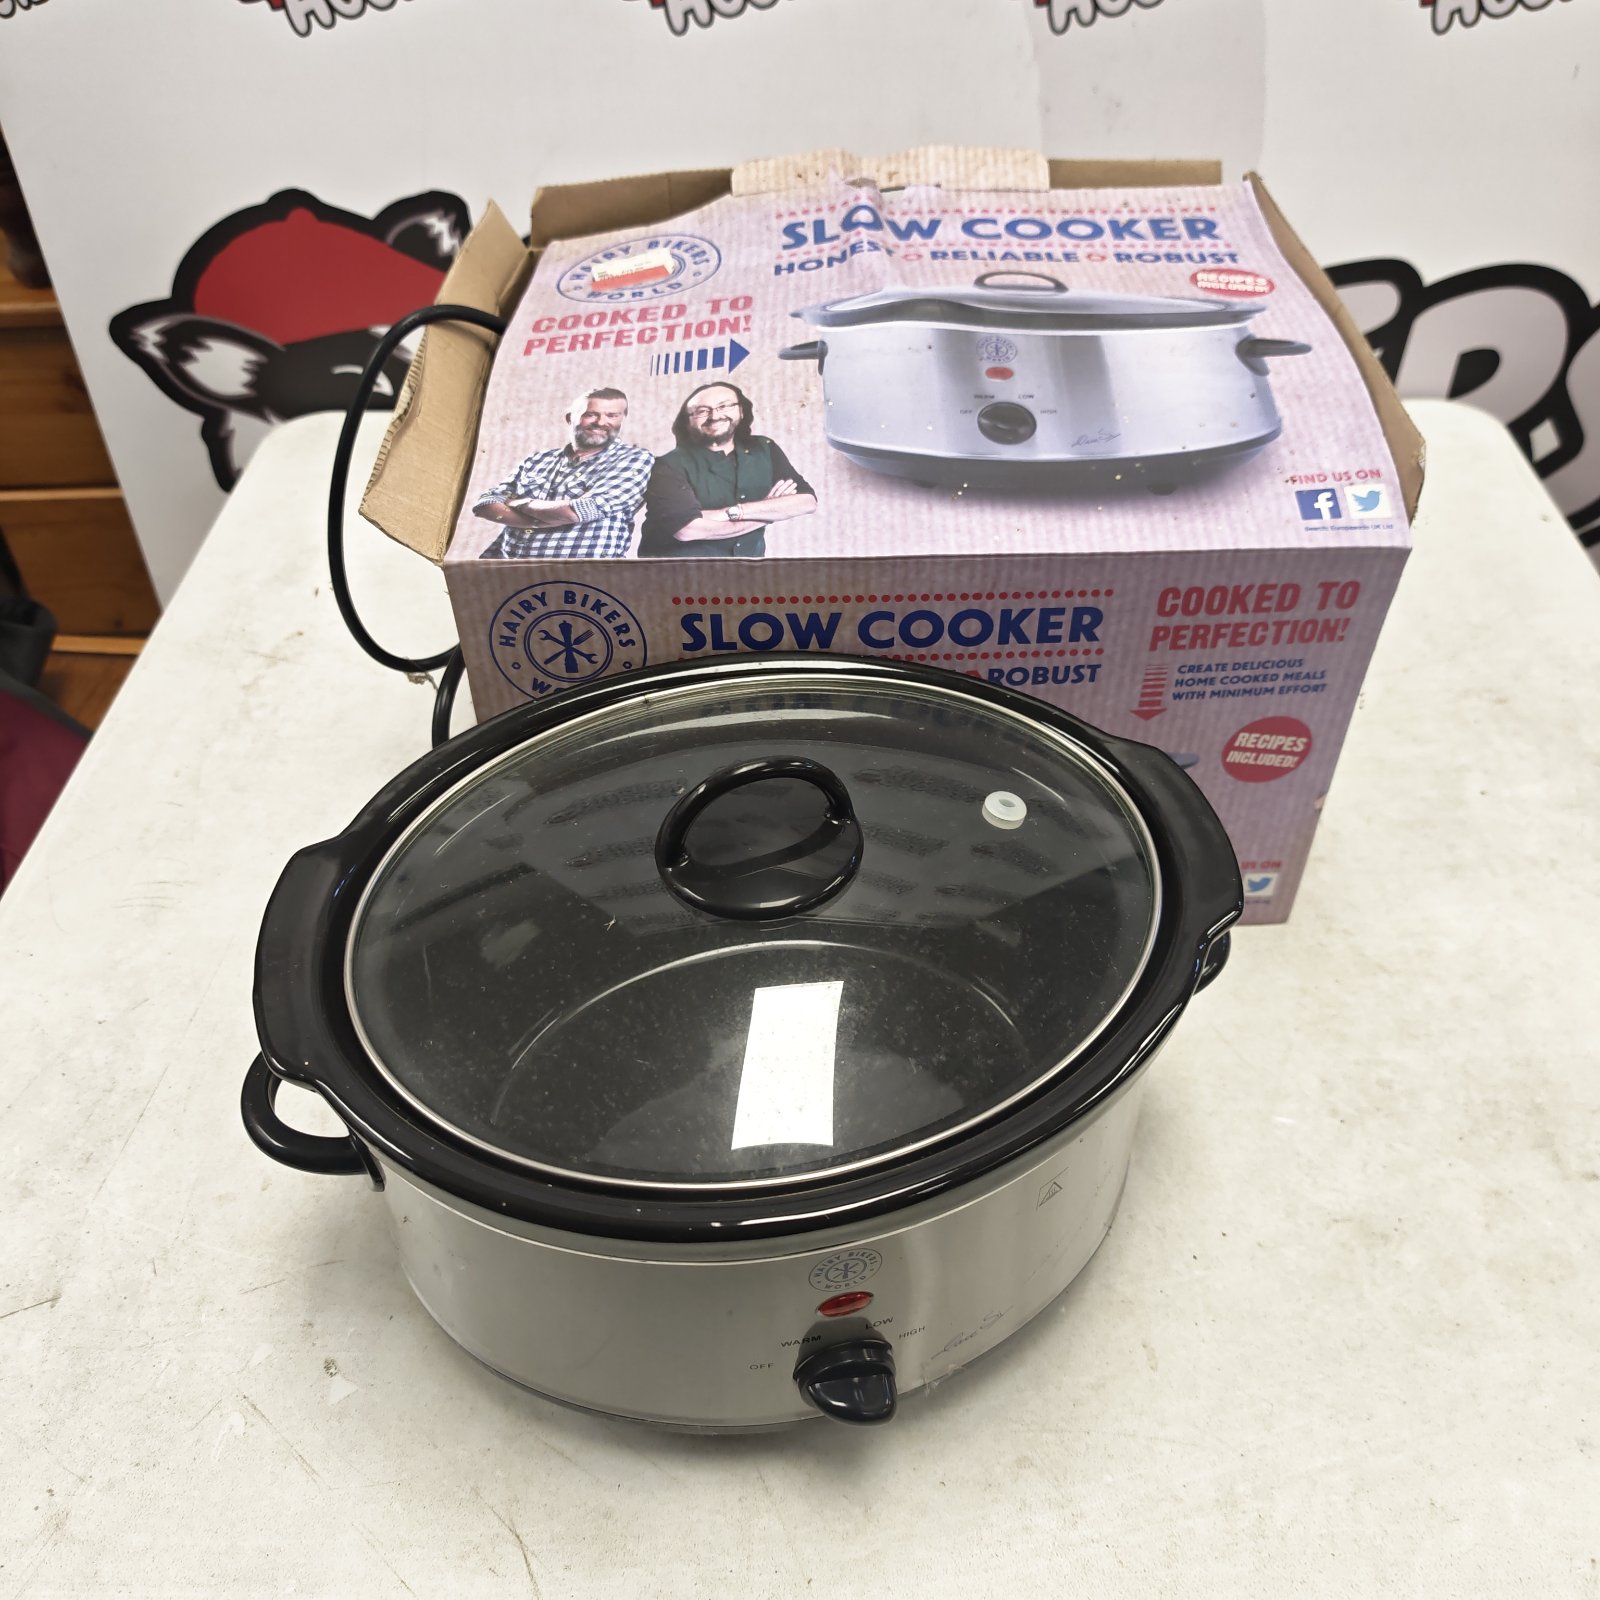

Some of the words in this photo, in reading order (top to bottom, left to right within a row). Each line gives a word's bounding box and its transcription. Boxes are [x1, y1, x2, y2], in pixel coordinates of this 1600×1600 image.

[782, 204, 941, 250] SLOW
[961, 217, 1223, 242] COOKER
[930, 250, 1080, 263] RELIABLE
[1114, 252, 1239, 264] ROBUST
[531, 304, 687, 334] COOKED
[705, 295, 753, 316] TO
[523, 315, 753, 356] PERFECTION!
[1289, 472, 1328, 485] FIND
[1332, 470, 1352, 482] US
[1355, 468, 1382, 480] ON
[1156, 583, 1302, 618] COOKED
[1317, 581, 1361, 611] TO
[499, 590, 548, 648] HAIRY
[563, 590, 636, 648] BIKERS
[680, 611, 842, 652] SLOW
[858, 606, 1104, 649] COOKER
[1149, 617, 1352, 653] PERFECTION!
[988, 664, 1102, 687] ROBUST
[1177, 662, 1229, 675] CREATE
[1232, 659, 1305, 672] DELICIOUS
[1174, 676, 1216, 688] HOME
[1220, 673, 1279, 686] COOKED
[1282, 670, 1326, 681] MEALS
[1172, 689, 1206, 701] WITH
[1209, 686, 1275, 699] MINIMUM
[1278, 683, 1327, 695] EFFORT
[1234, 731, 1309, 753] RECIPES
[1226, 750, 1299, 768] INCLUDED!
[848, 1251, 878, 1265] BIKERS
[824, 1275, 866, 1289] WORLD
[865, 1317, 894, 1330] LOW
[899, 1326, 926, 1339] HIGH
[780, 1335, 822, 1348] WARM
[749, 1362, 775, 1370] OFF
